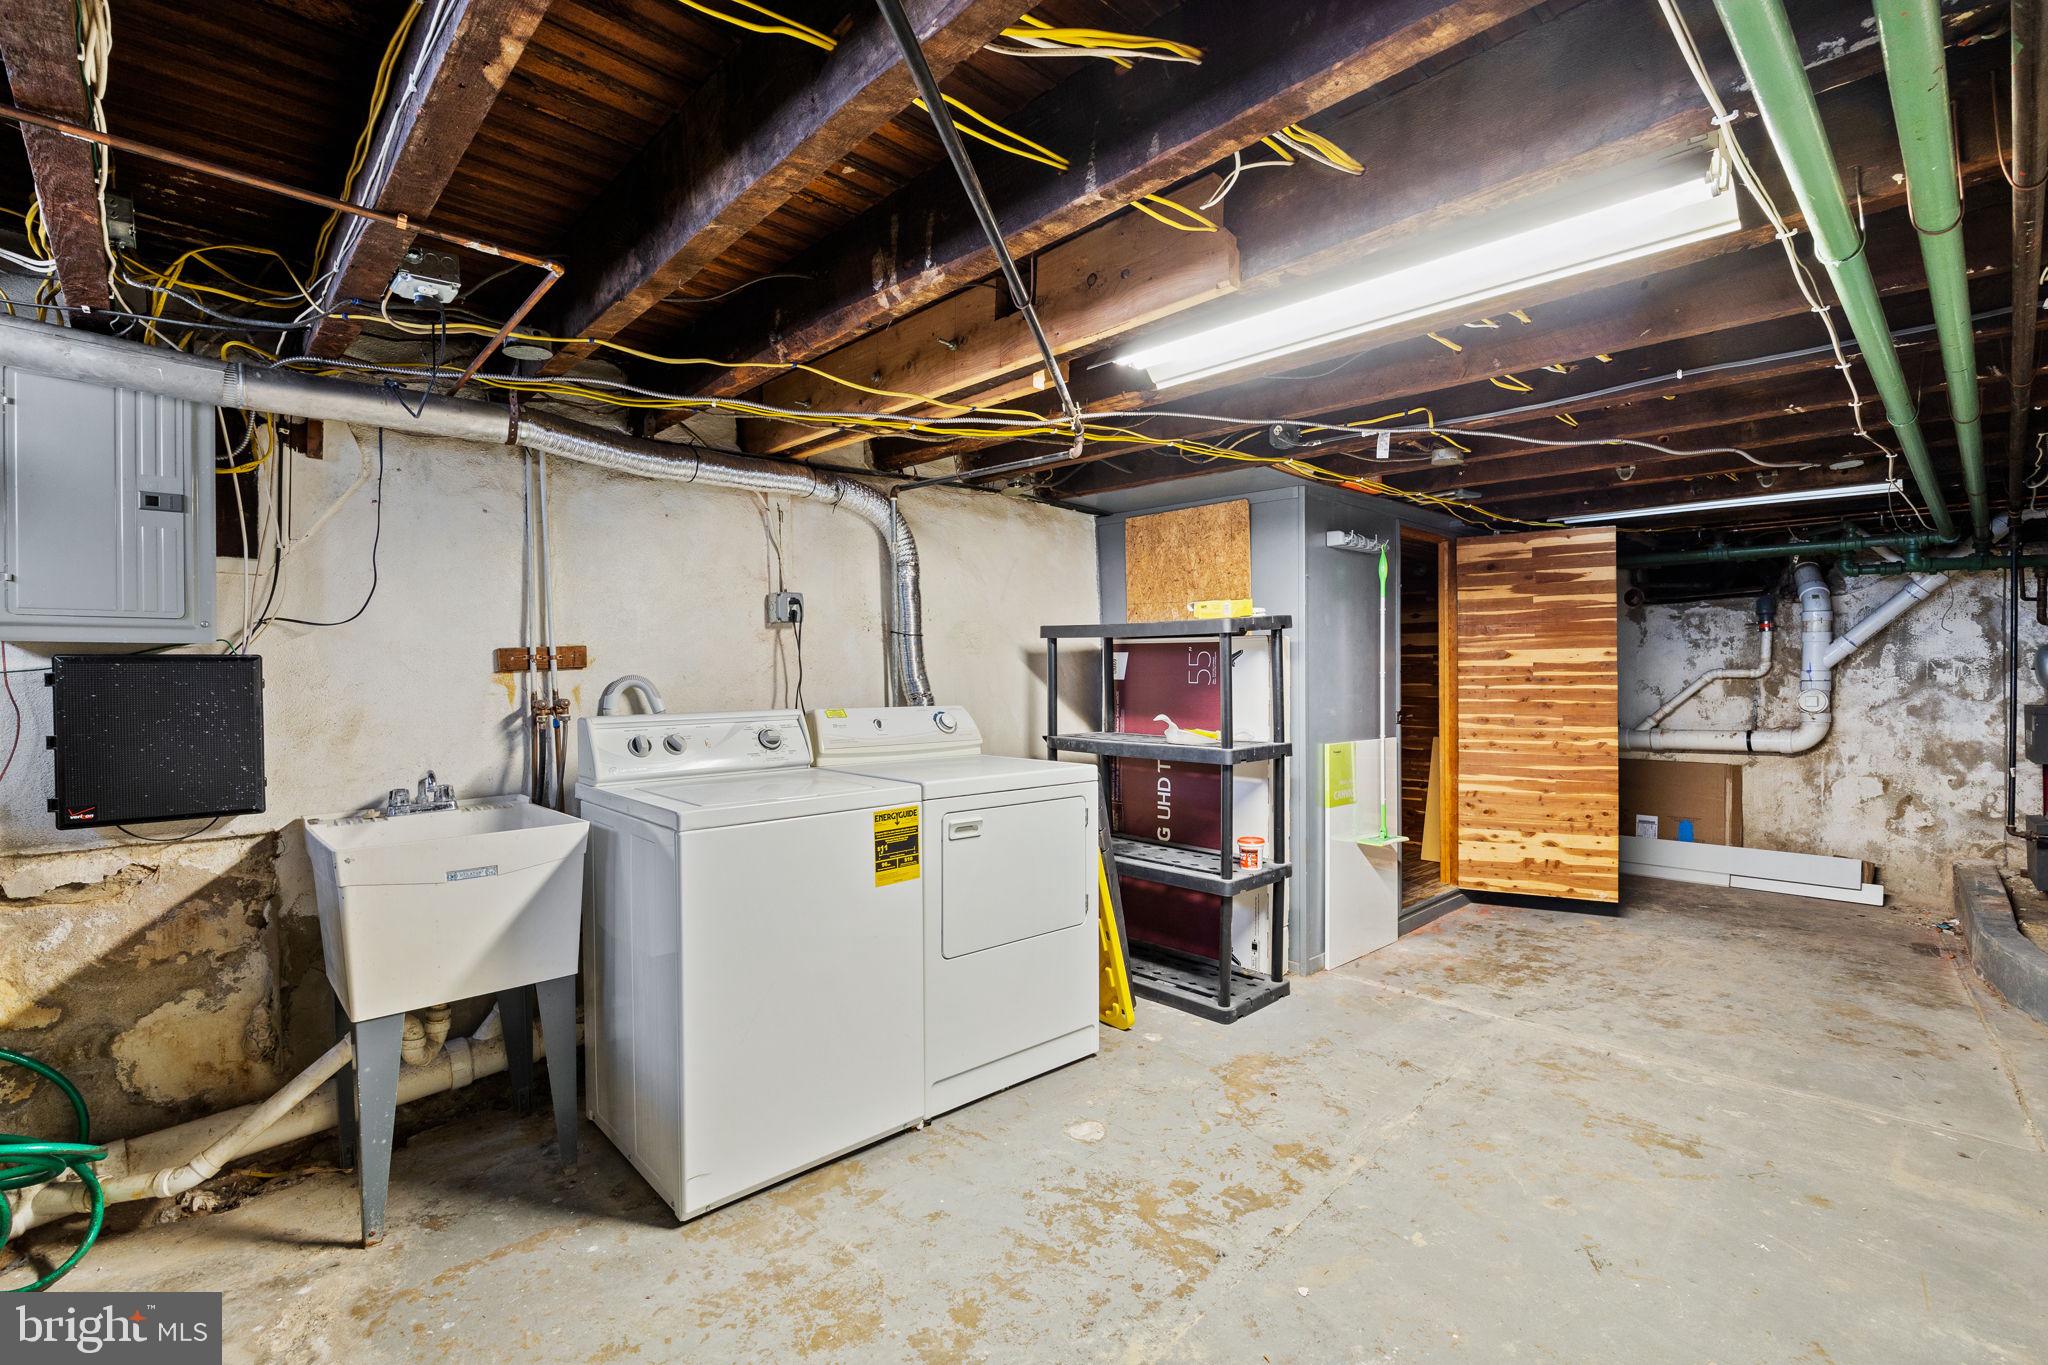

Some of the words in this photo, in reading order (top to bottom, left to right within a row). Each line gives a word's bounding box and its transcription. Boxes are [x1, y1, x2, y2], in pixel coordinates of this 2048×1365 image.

[1157, 760, 1171, 773] T
[1157, 777, 1171, 820] UHD
[1157, 827, 1171, 842] G
